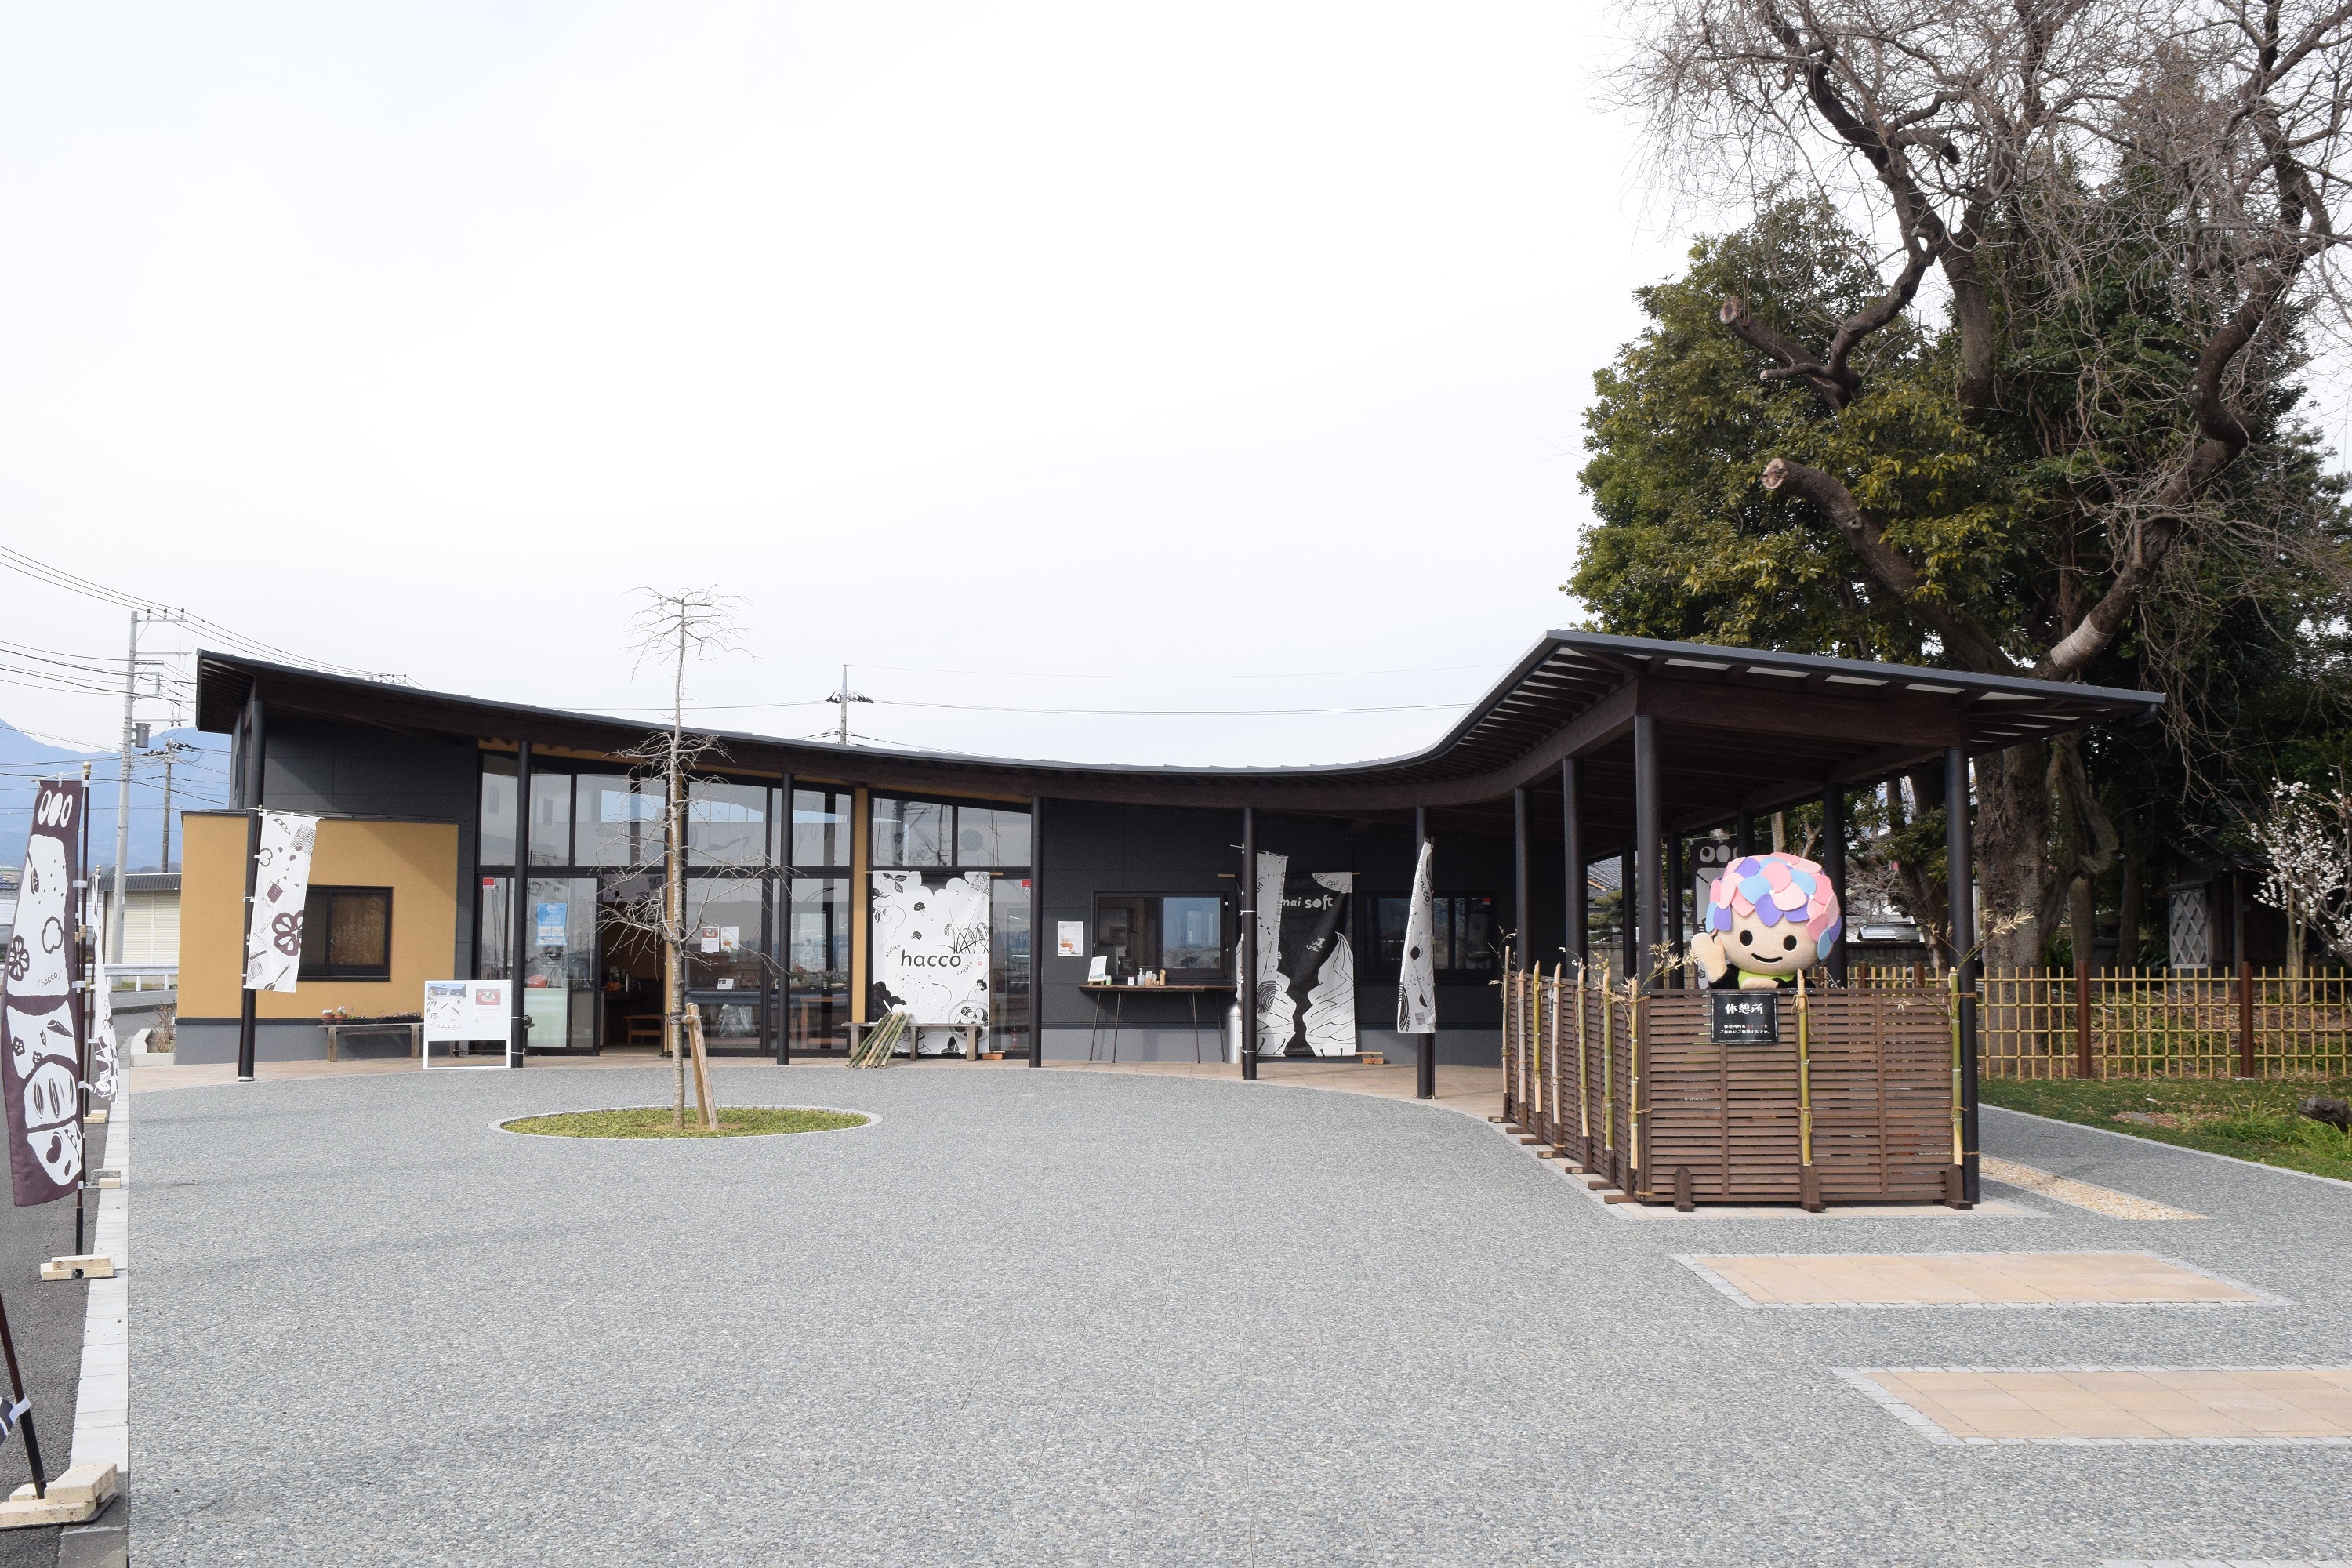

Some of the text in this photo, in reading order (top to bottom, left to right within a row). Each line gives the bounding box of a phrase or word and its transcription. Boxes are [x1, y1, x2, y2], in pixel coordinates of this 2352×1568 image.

[1281, 894, 1333, 910] mai soft
[885, 944, 901, 958] atelier
[900, 949, 962, 967] hacco
[956, 961, 973, 975] atelier
[41, 972, 58, 988] hacco
[1725, 1003, 1765, 1014] 休憩所
